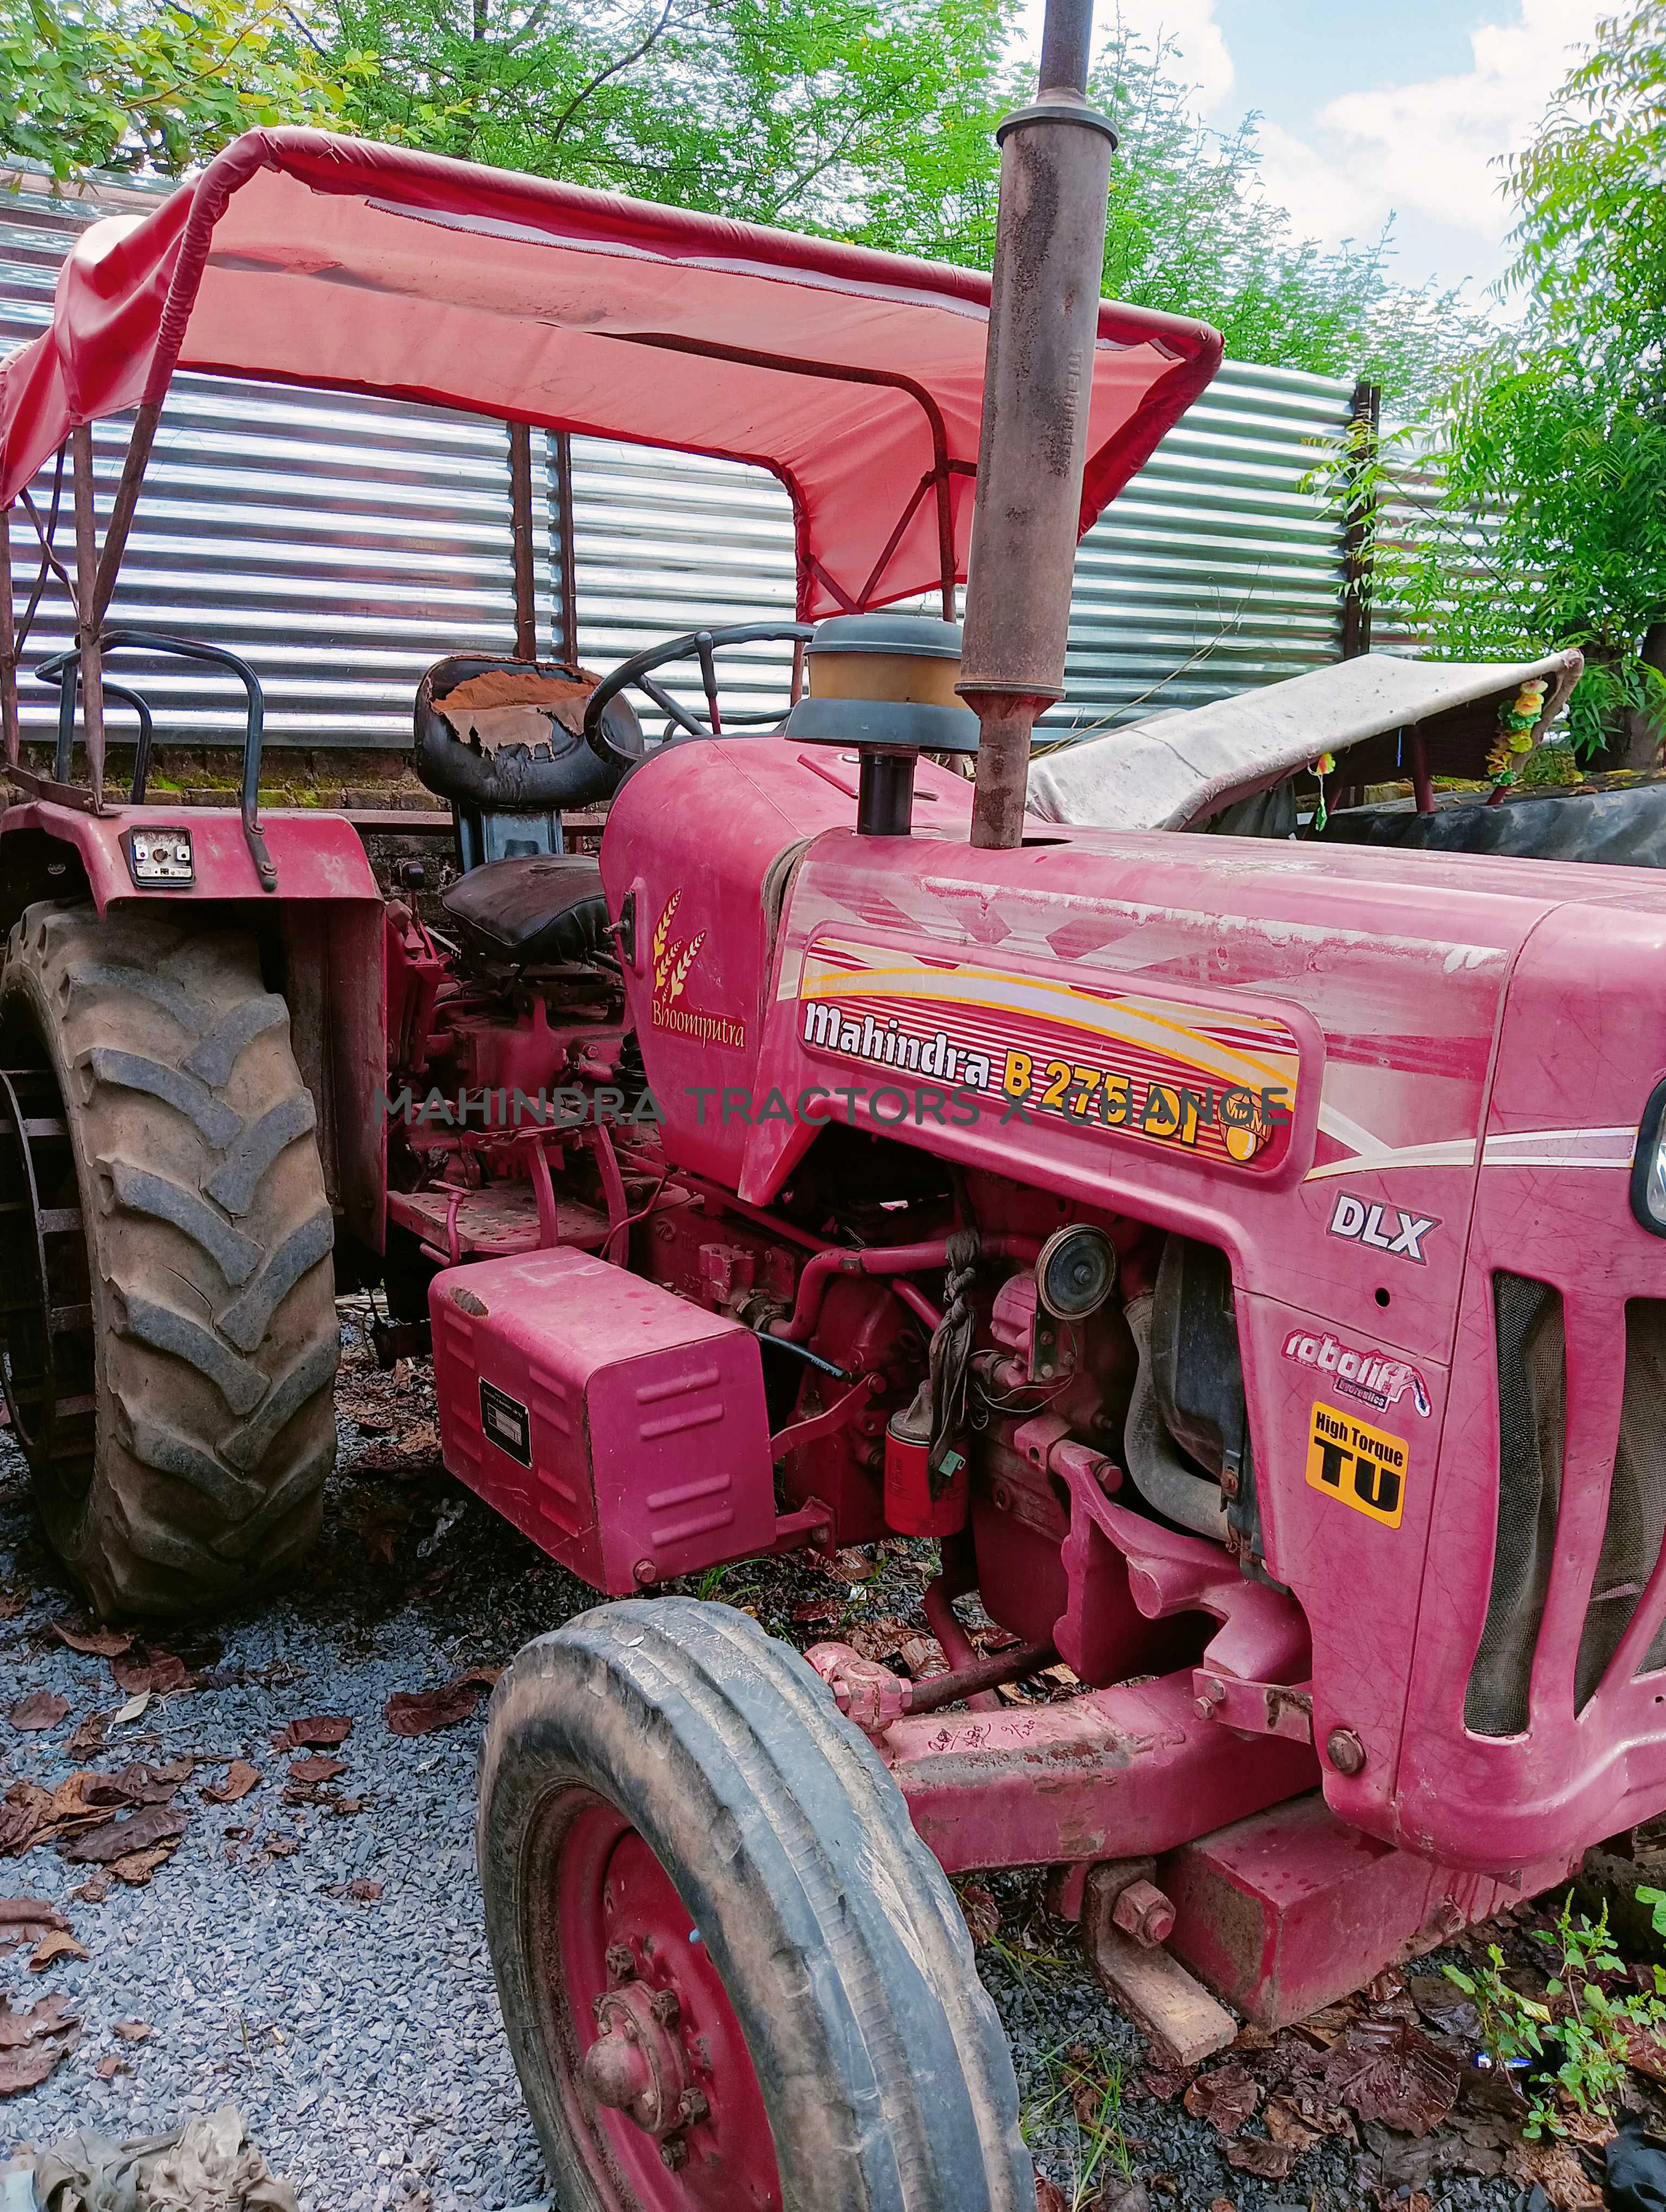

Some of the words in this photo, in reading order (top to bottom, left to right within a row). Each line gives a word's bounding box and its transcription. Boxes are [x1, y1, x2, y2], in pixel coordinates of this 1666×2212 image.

[652, 1000, 745, 1048] Bhoomiputra
[804, 1002, 990, 1089] Mahindra
[1004, 1050, 1032, 1097] B
[1041, 1060, 1130, 1124] 275
[1330, 1195, 1434, 1259] DLX
[1315, 1411, 1348, 1442] High
[1351, 1426, 1404, 1467] Torque
[1314, 1435, 1401, 1512] TU
